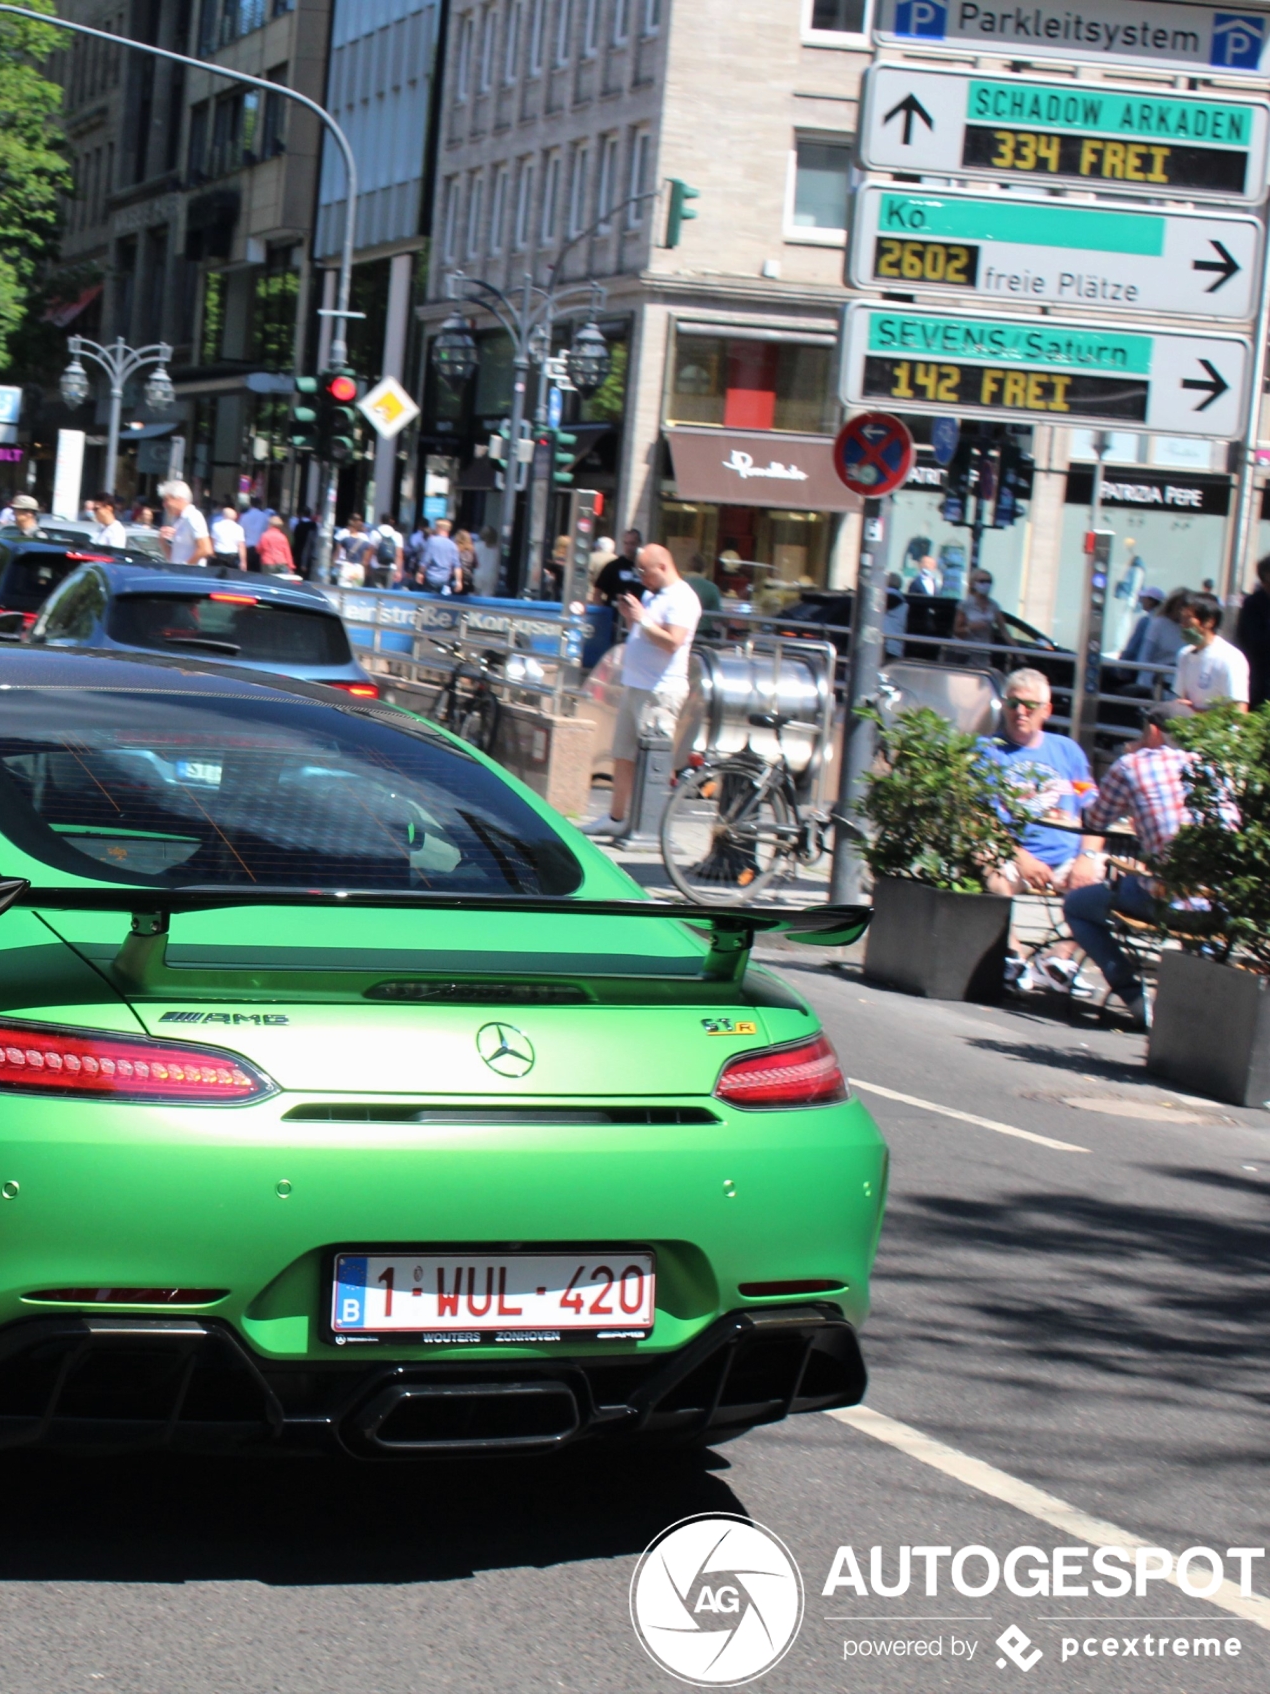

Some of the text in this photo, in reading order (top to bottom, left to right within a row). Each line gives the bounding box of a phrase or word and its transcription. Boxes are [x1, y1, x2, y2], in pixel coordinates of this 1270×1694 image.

[958, 2, 1200, 54] Parkleitsystem
[975, 88, 1245, 141] SCHADOW ARKADEN
[992, 131, 1171, 183] 334 FREI
[878, 239, 969, 284] 2602
[985, 267, 1139, 302] freie Plätze
[891, 362, 1072, 411] 142 FREI
[1164, 485, 1204, 508] PEPE
[201, 1012, 290, 1026] AMG
[342, 1298, 360, 1323] B
[423, 1331, 561, 1343] WOUTERS ZONHOVEN
